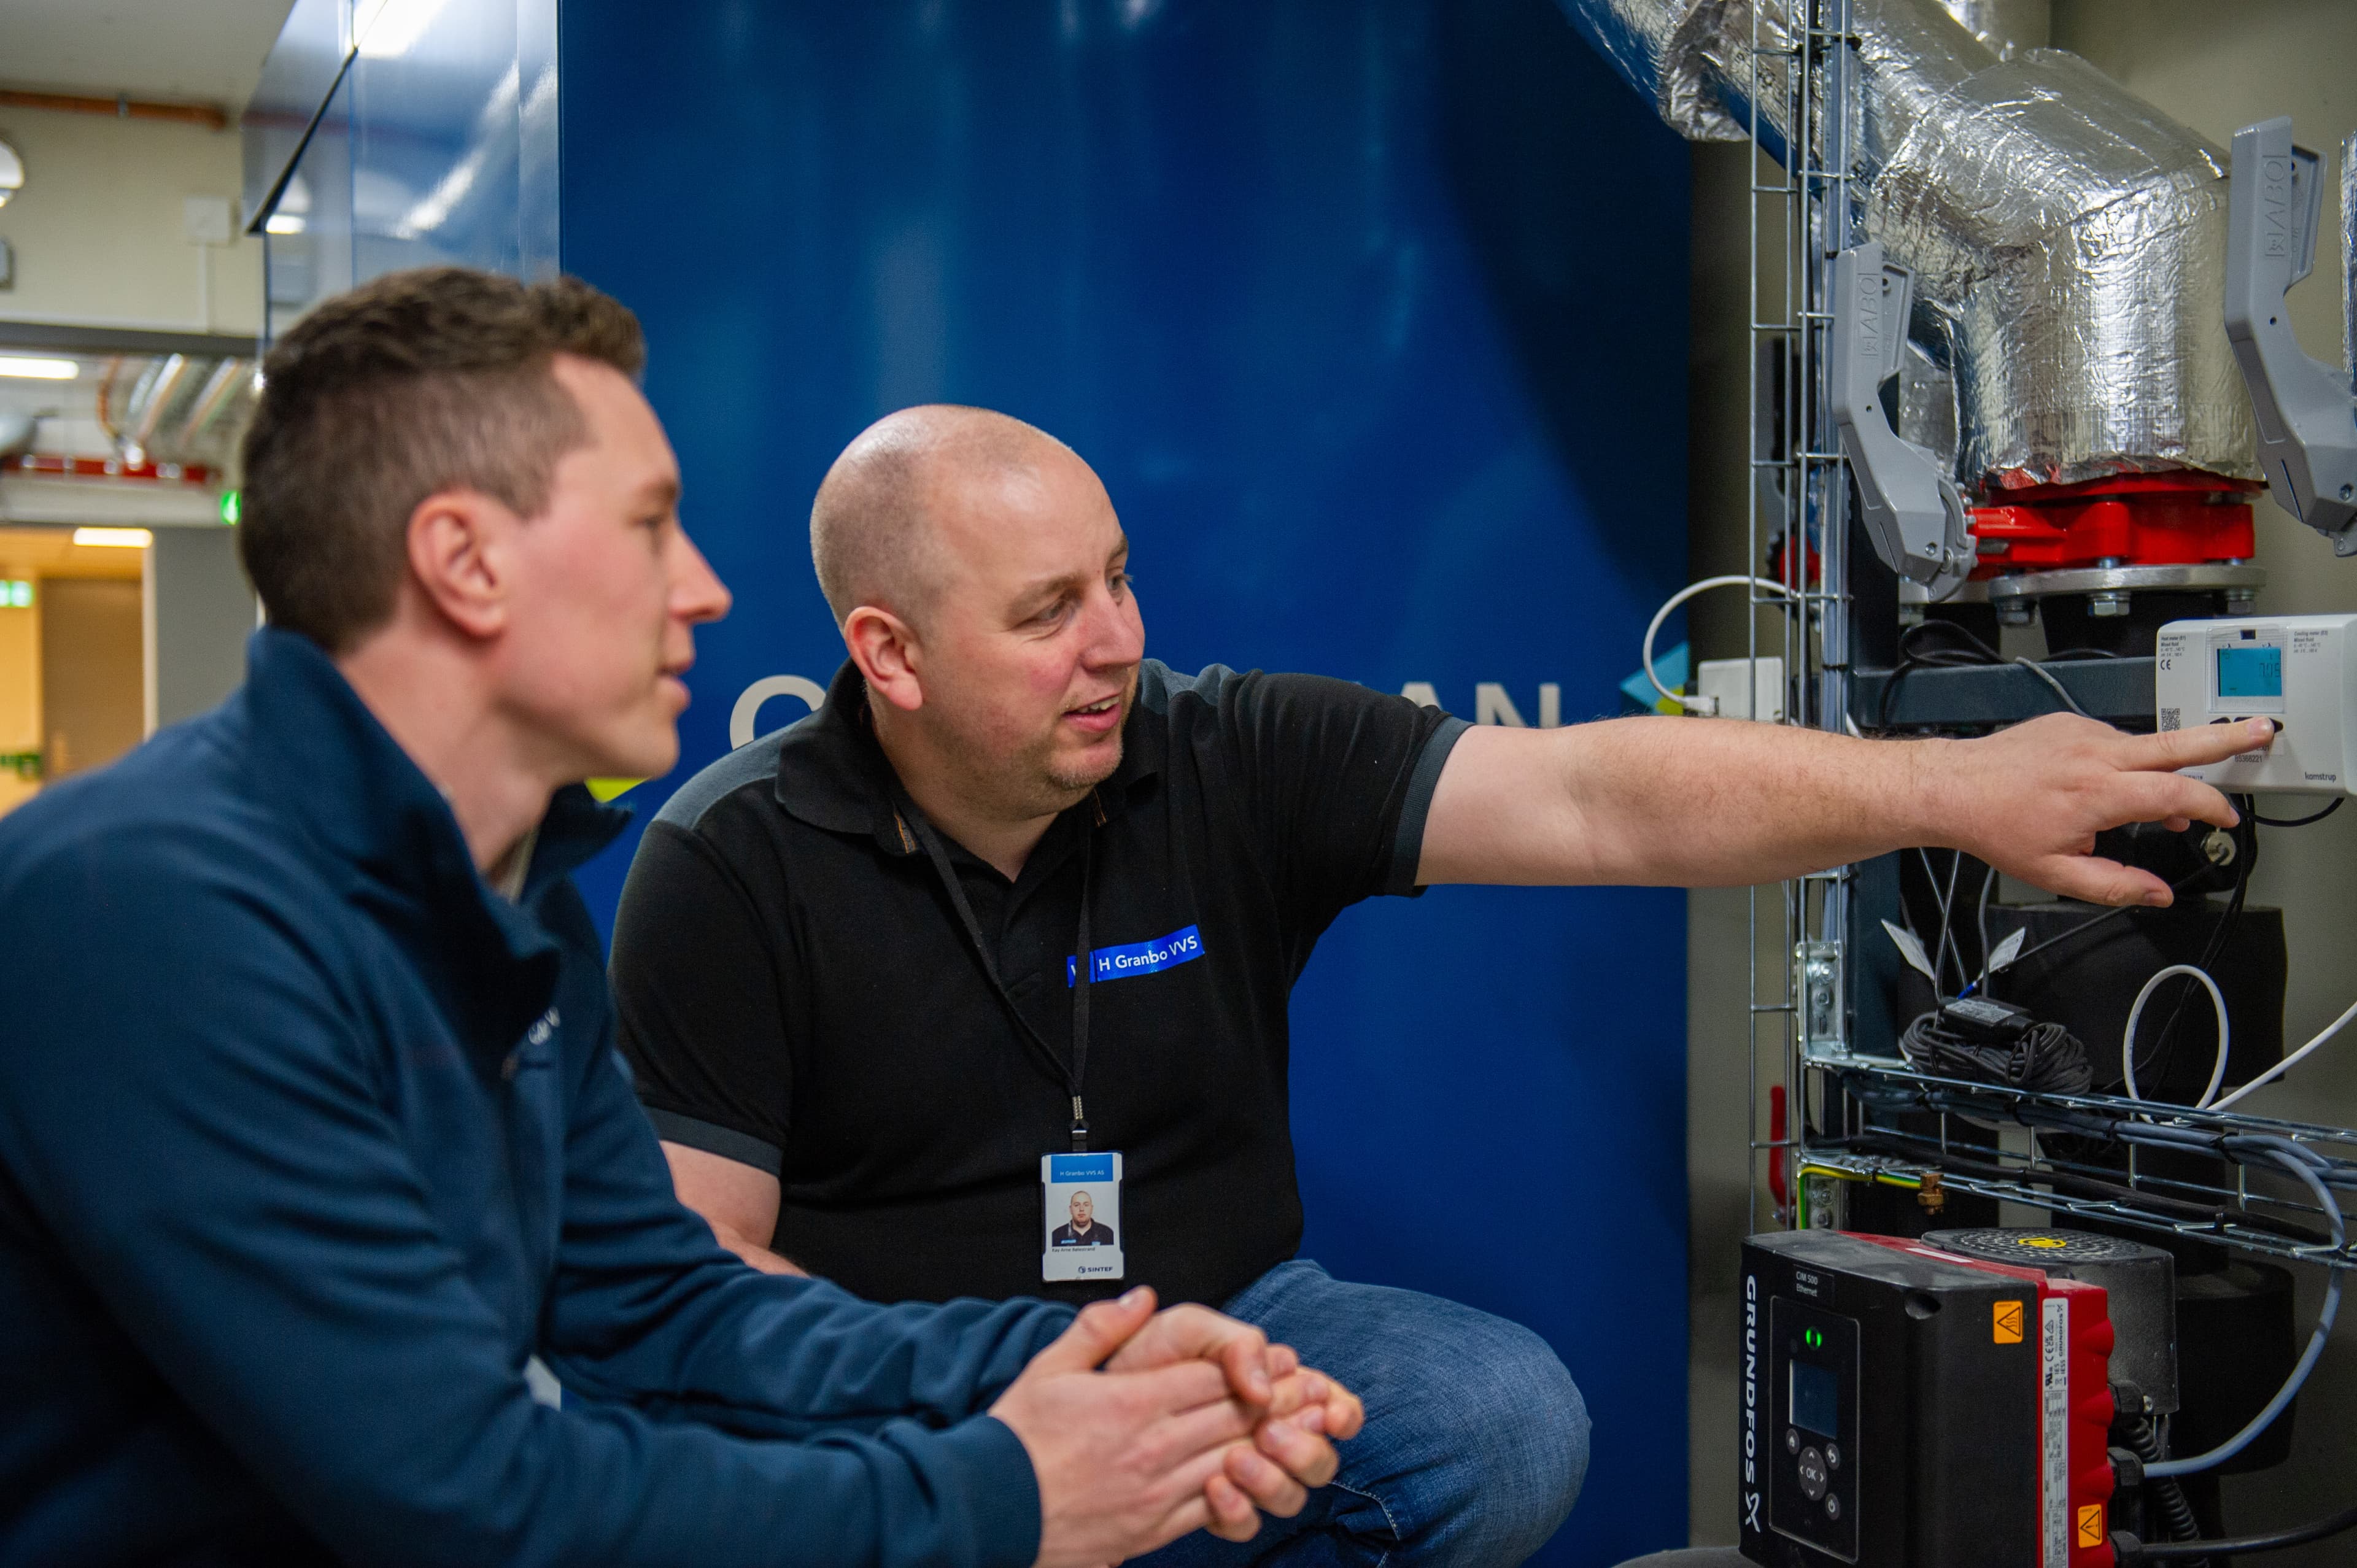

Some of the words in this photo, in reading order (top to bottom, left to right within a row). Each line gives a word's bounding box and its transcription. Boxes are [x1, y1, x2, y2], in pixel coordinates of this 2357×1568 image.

[2304, 771, 2337, 783] kamstrup
[1099, 957, 1110, 971] H
[1115, 950, 1167, 969] Granbo
[1169, 935, 1198, 956] VVS
[1807, 1275, 1818, 1285] 500
[1745, 1274, 1757, 1485] GRUNDFOS
[1806, 1467, 1816, 1481] OK
